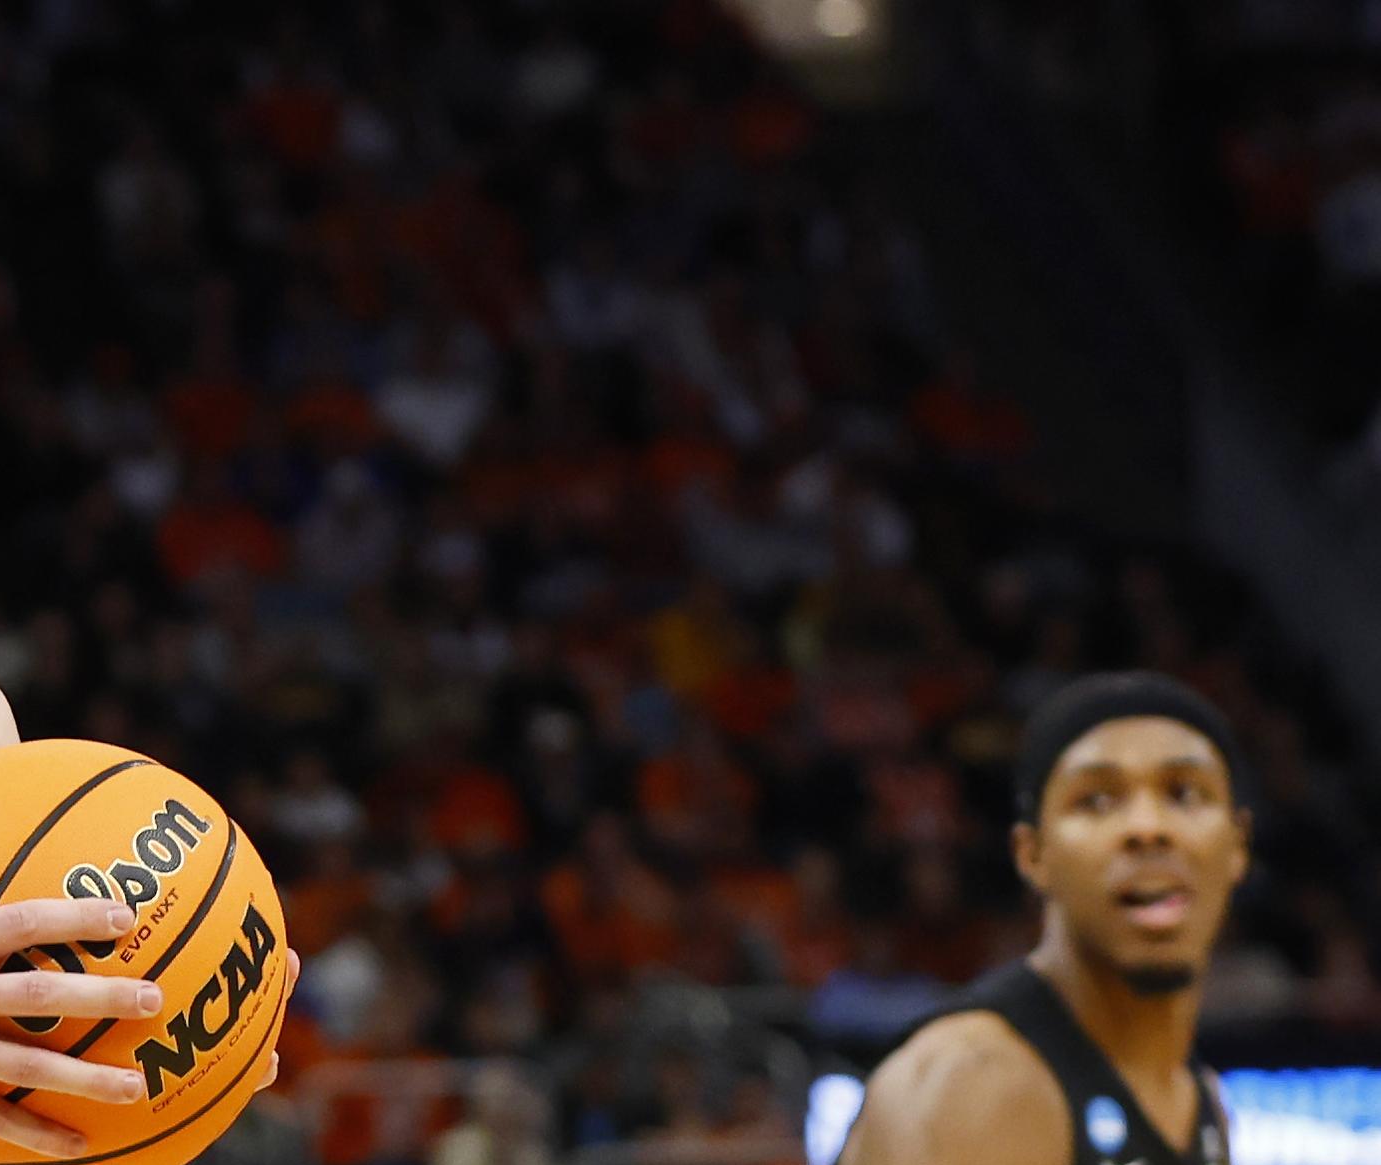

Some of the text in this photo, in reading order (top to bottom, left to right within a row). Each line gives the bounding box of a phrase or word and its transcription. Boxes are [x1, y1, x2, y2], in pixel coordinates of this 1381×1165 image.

[120, 887, 179, 964] EVO NXT
[133, 903, 276, 1101] NCAA
